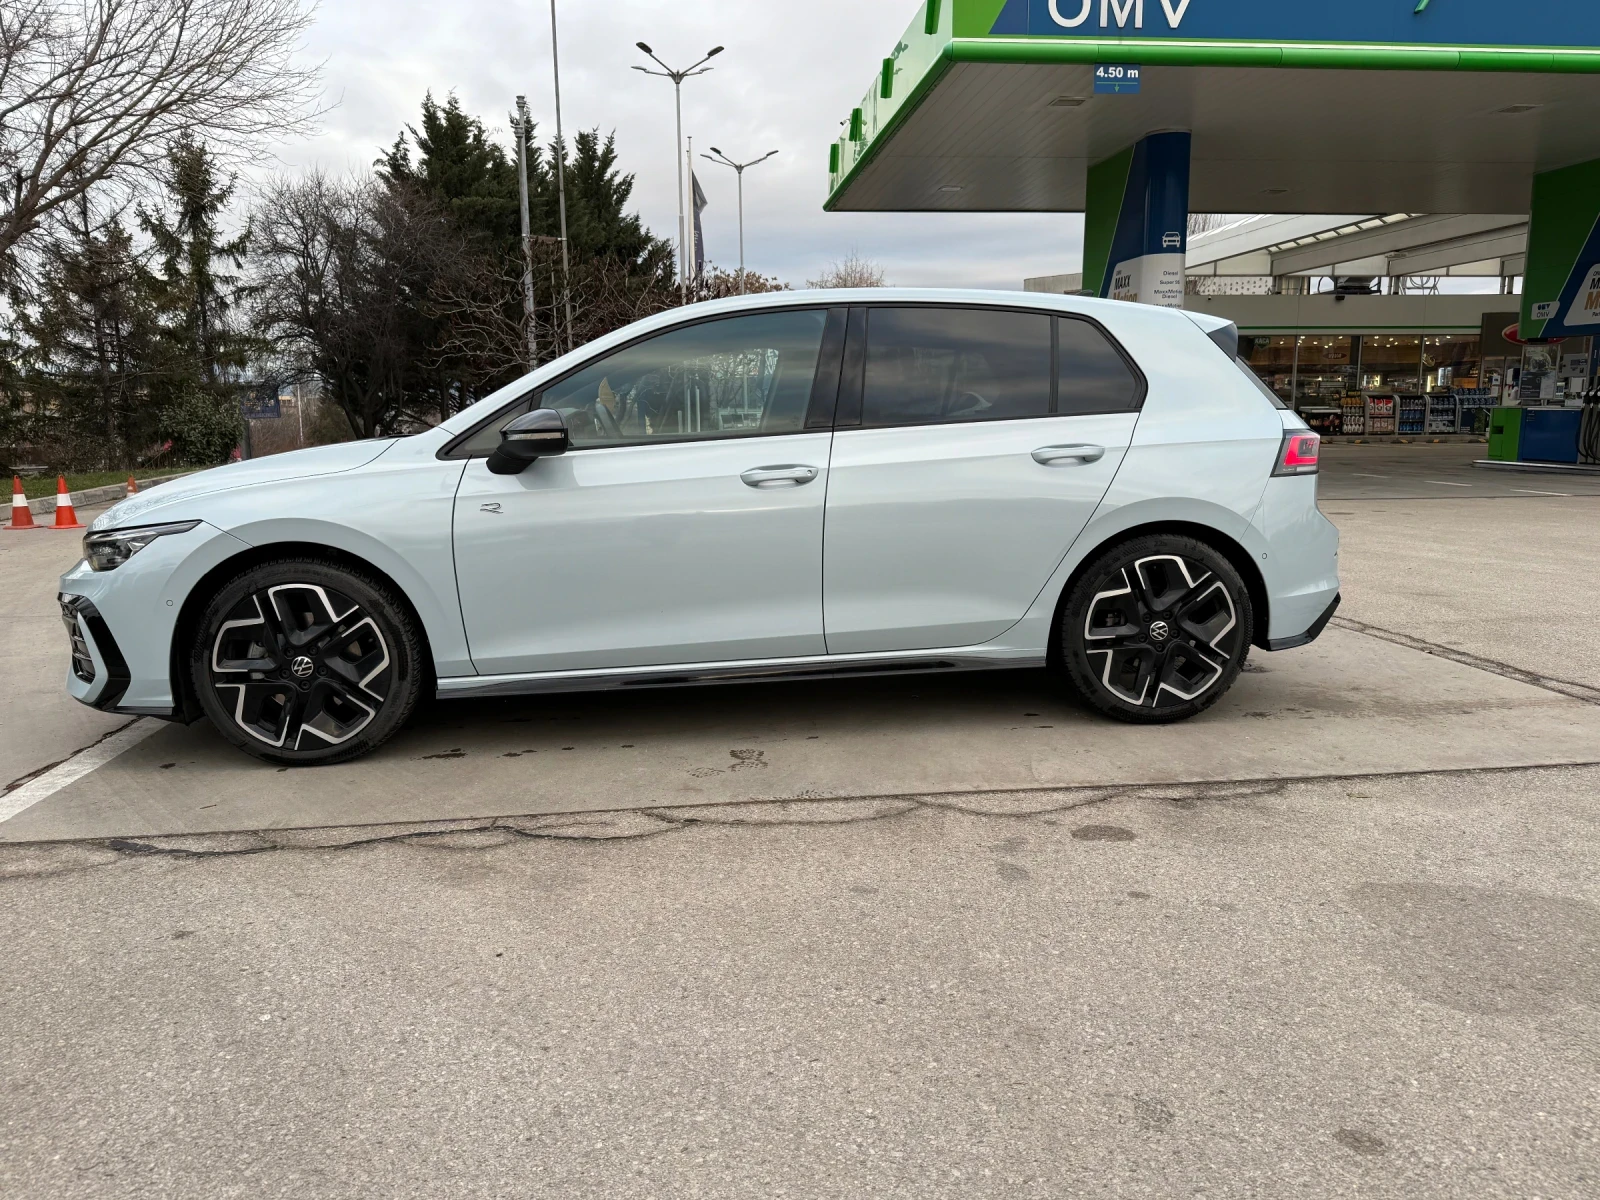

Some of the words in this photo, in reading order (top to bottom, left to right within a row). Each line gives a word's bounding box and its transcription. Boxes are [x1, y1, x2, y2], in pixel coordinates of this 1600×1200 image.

[1096, 66, 1124, 78] 4.50
[1127, 68, 1139, 78] m
[1114, 275, 1131, 290] MAXX
